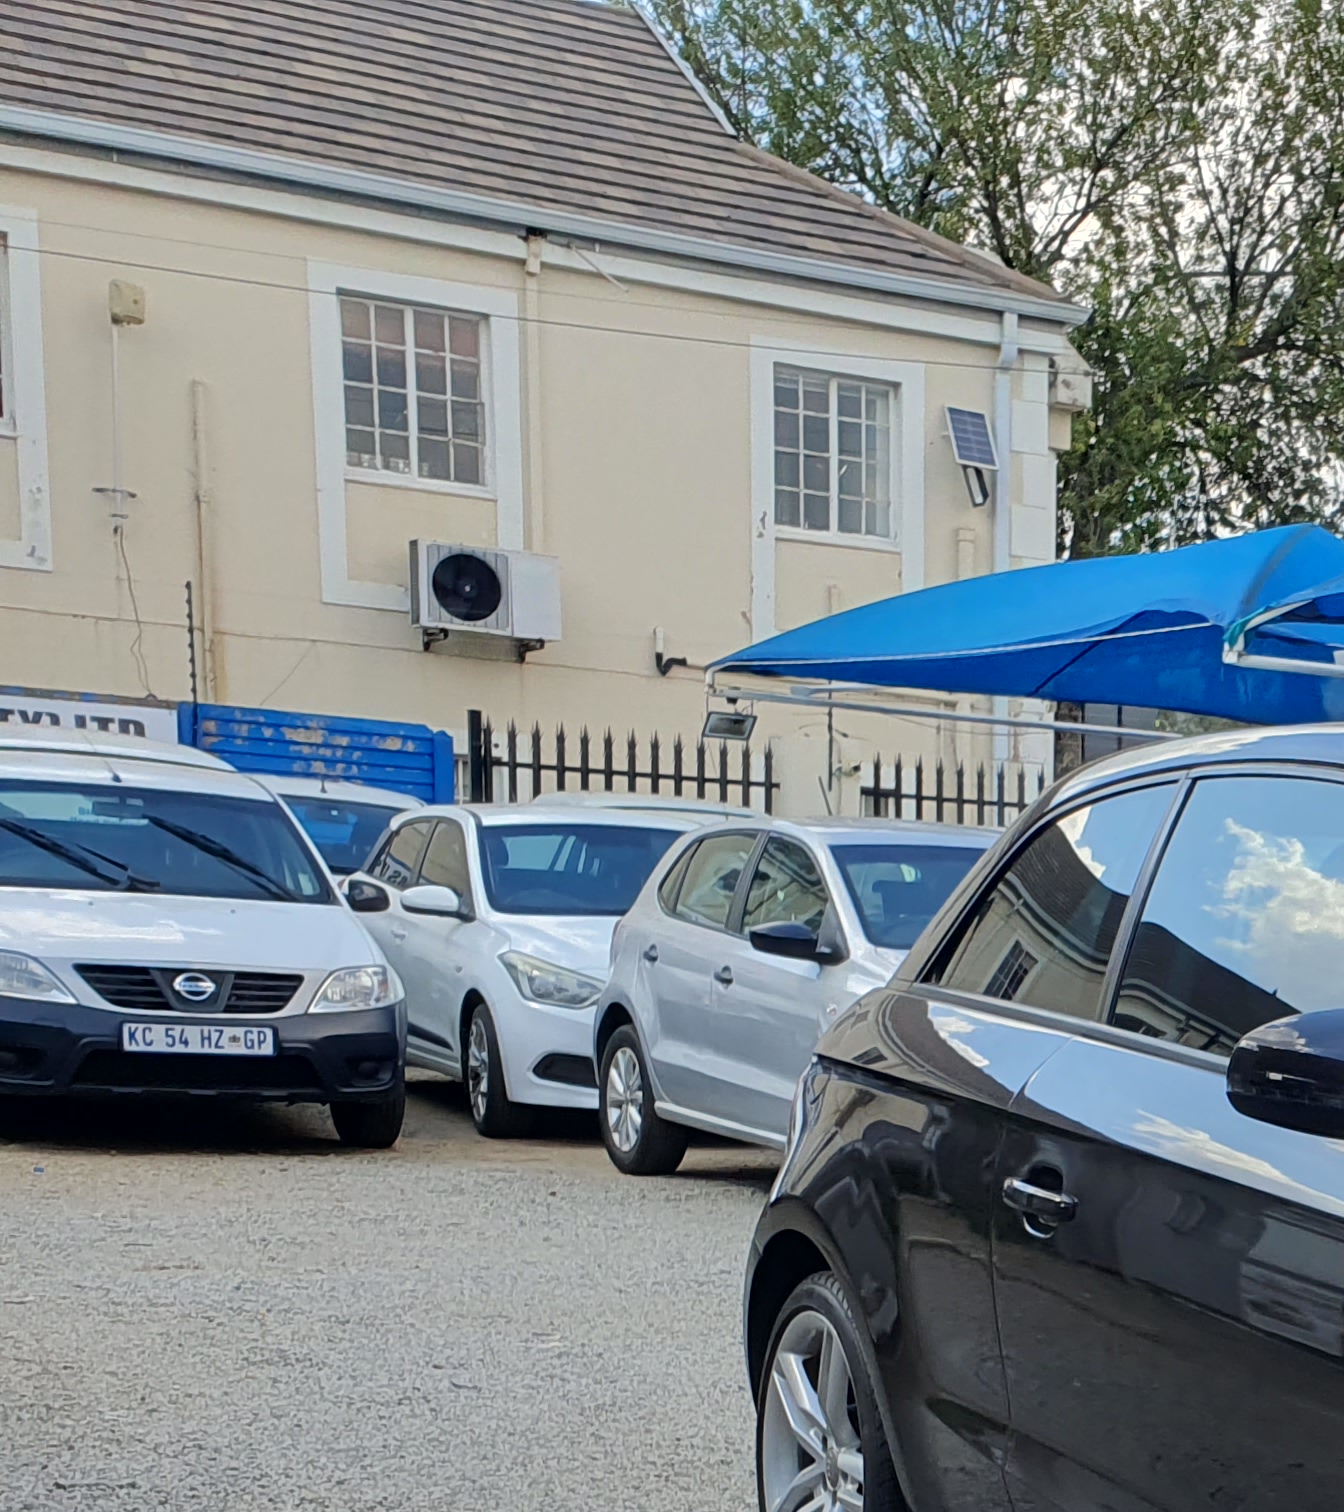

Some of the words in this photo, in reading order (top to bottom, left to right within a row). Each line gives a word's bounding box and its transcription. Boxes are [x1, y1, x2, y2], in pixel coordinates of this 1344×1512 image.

[128, 1026, 154, 1047] KC
[165, 1028, 190, 1048] 54
[201, 1029, 225, 1049] HZ
[244, 1029, 267, 1050] GP
